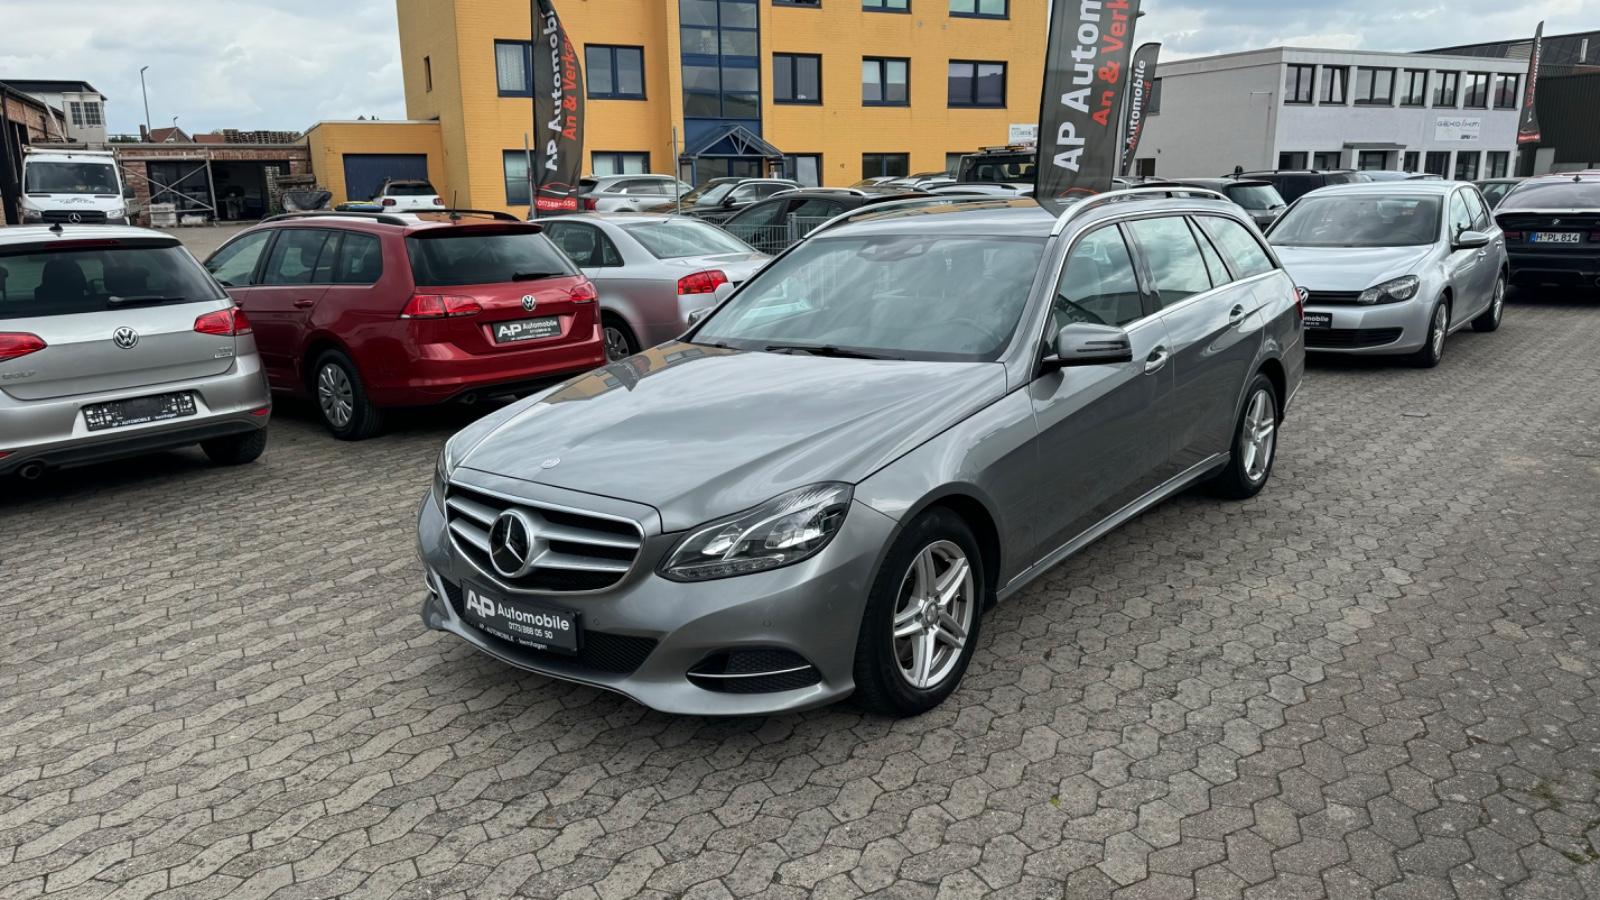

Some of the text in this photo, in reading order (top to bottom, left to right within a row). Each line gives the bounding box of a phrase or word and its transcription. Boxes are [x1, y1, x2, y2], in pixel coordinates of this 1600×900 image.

[1098, 60, 1121, 84] &
[562, 95, 577, 111] &
[1092, 91, 1116, 127] An
[1126, 60, 1146, 145] Automobile
[562, 115, 577, 141] An
[545, 139, 558, 171] AP
[1053, 121, 1086, 173] AP
[1548, 232, 1559, 242] PL
[1561, 232, 1578, 242] 814
[498, 323, 522, 338] AP
[522, 320, 558, 330] Automobile
[466, 589, 570, 631] AP Automobile
[544, 630, 554, 639] 50
